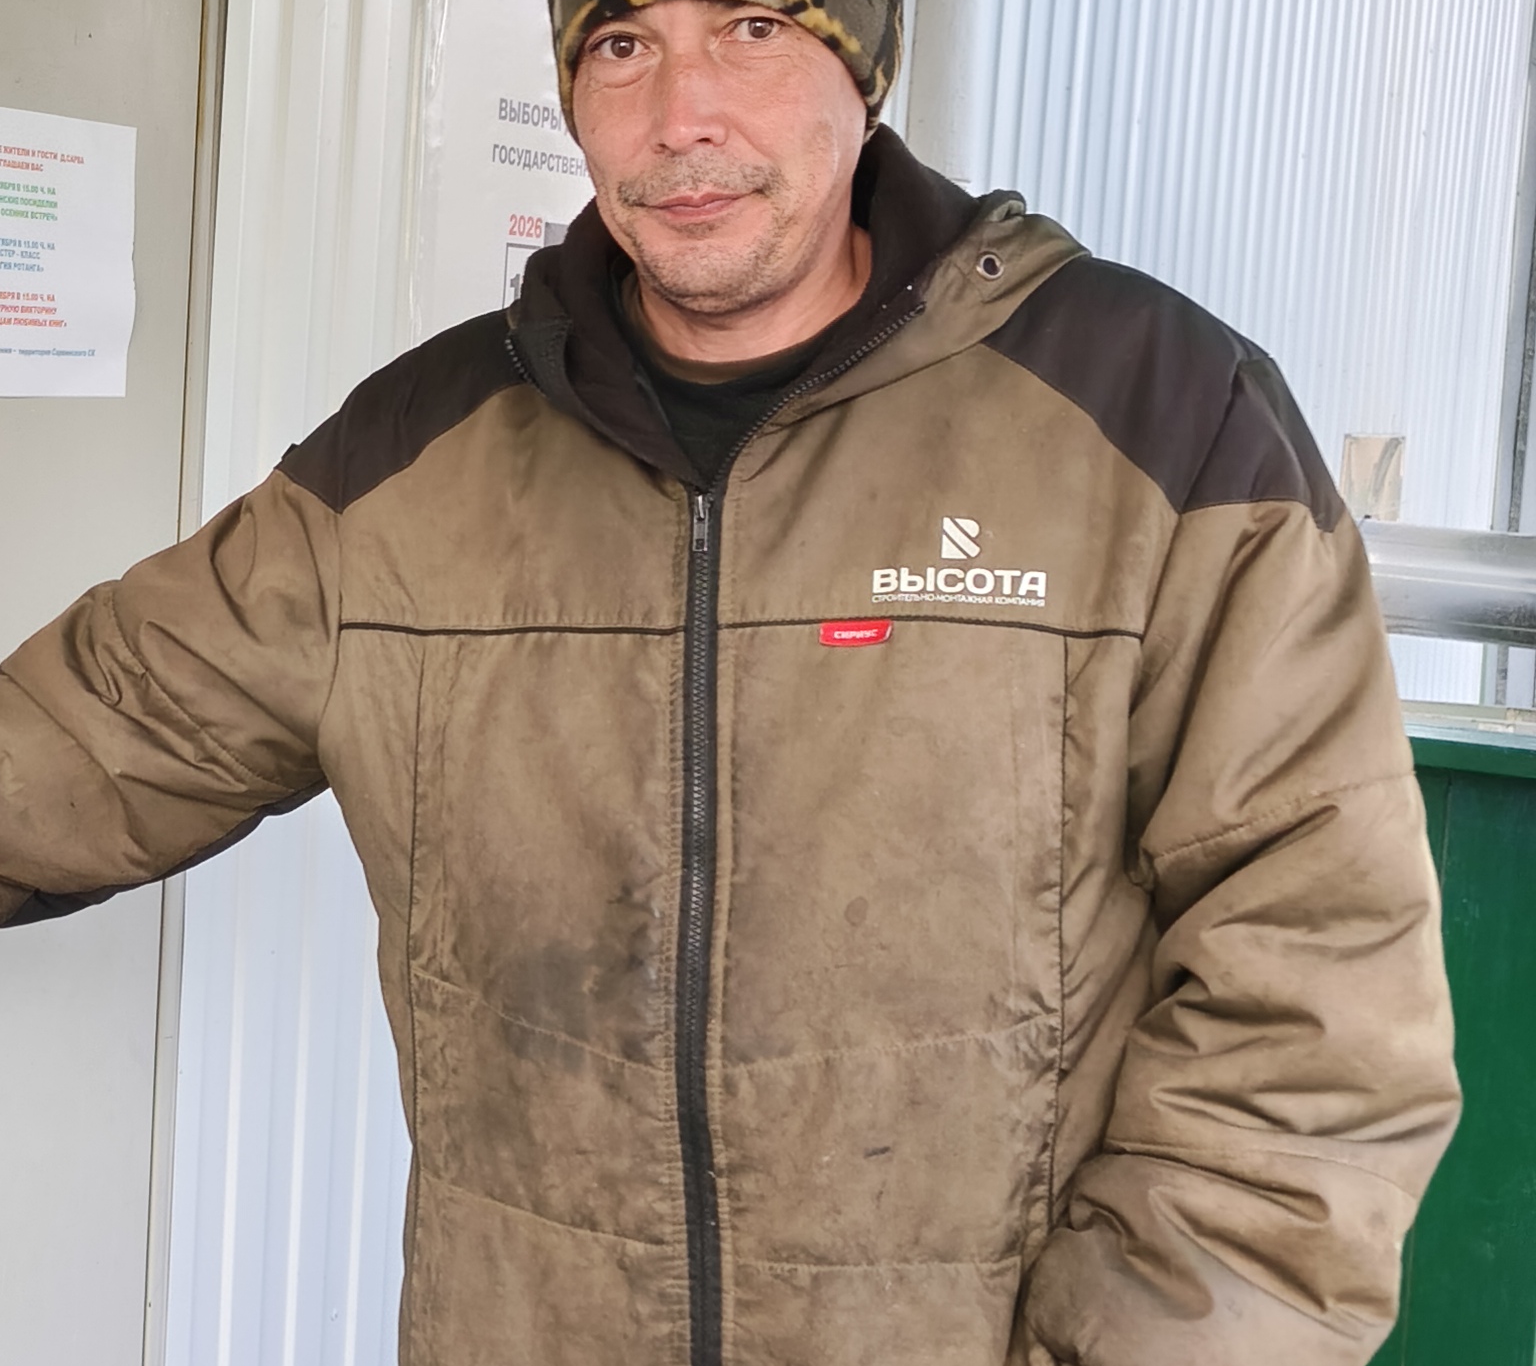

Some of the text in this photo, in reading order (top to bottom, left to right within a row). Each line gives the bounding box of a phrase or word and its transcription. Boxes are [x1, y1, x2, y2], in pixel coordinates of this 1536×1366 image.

[499, 98, 561, 131] ВЫБОРЫ
[4, 146, 30, 156] ЖИТЕЛИ
[37, 150, 58, 160] ГОСТИ
[31, 163, 44, 172] ВАС
[47, 187, 56, 195] НА
[508, 214, 543, 239] 2026
[21, 250, 40, 260] КЛАСС
[872, 567, 1047, 597] ВЫСОТА
[995, 596, 1045, 607] КОМПАНИЯ
